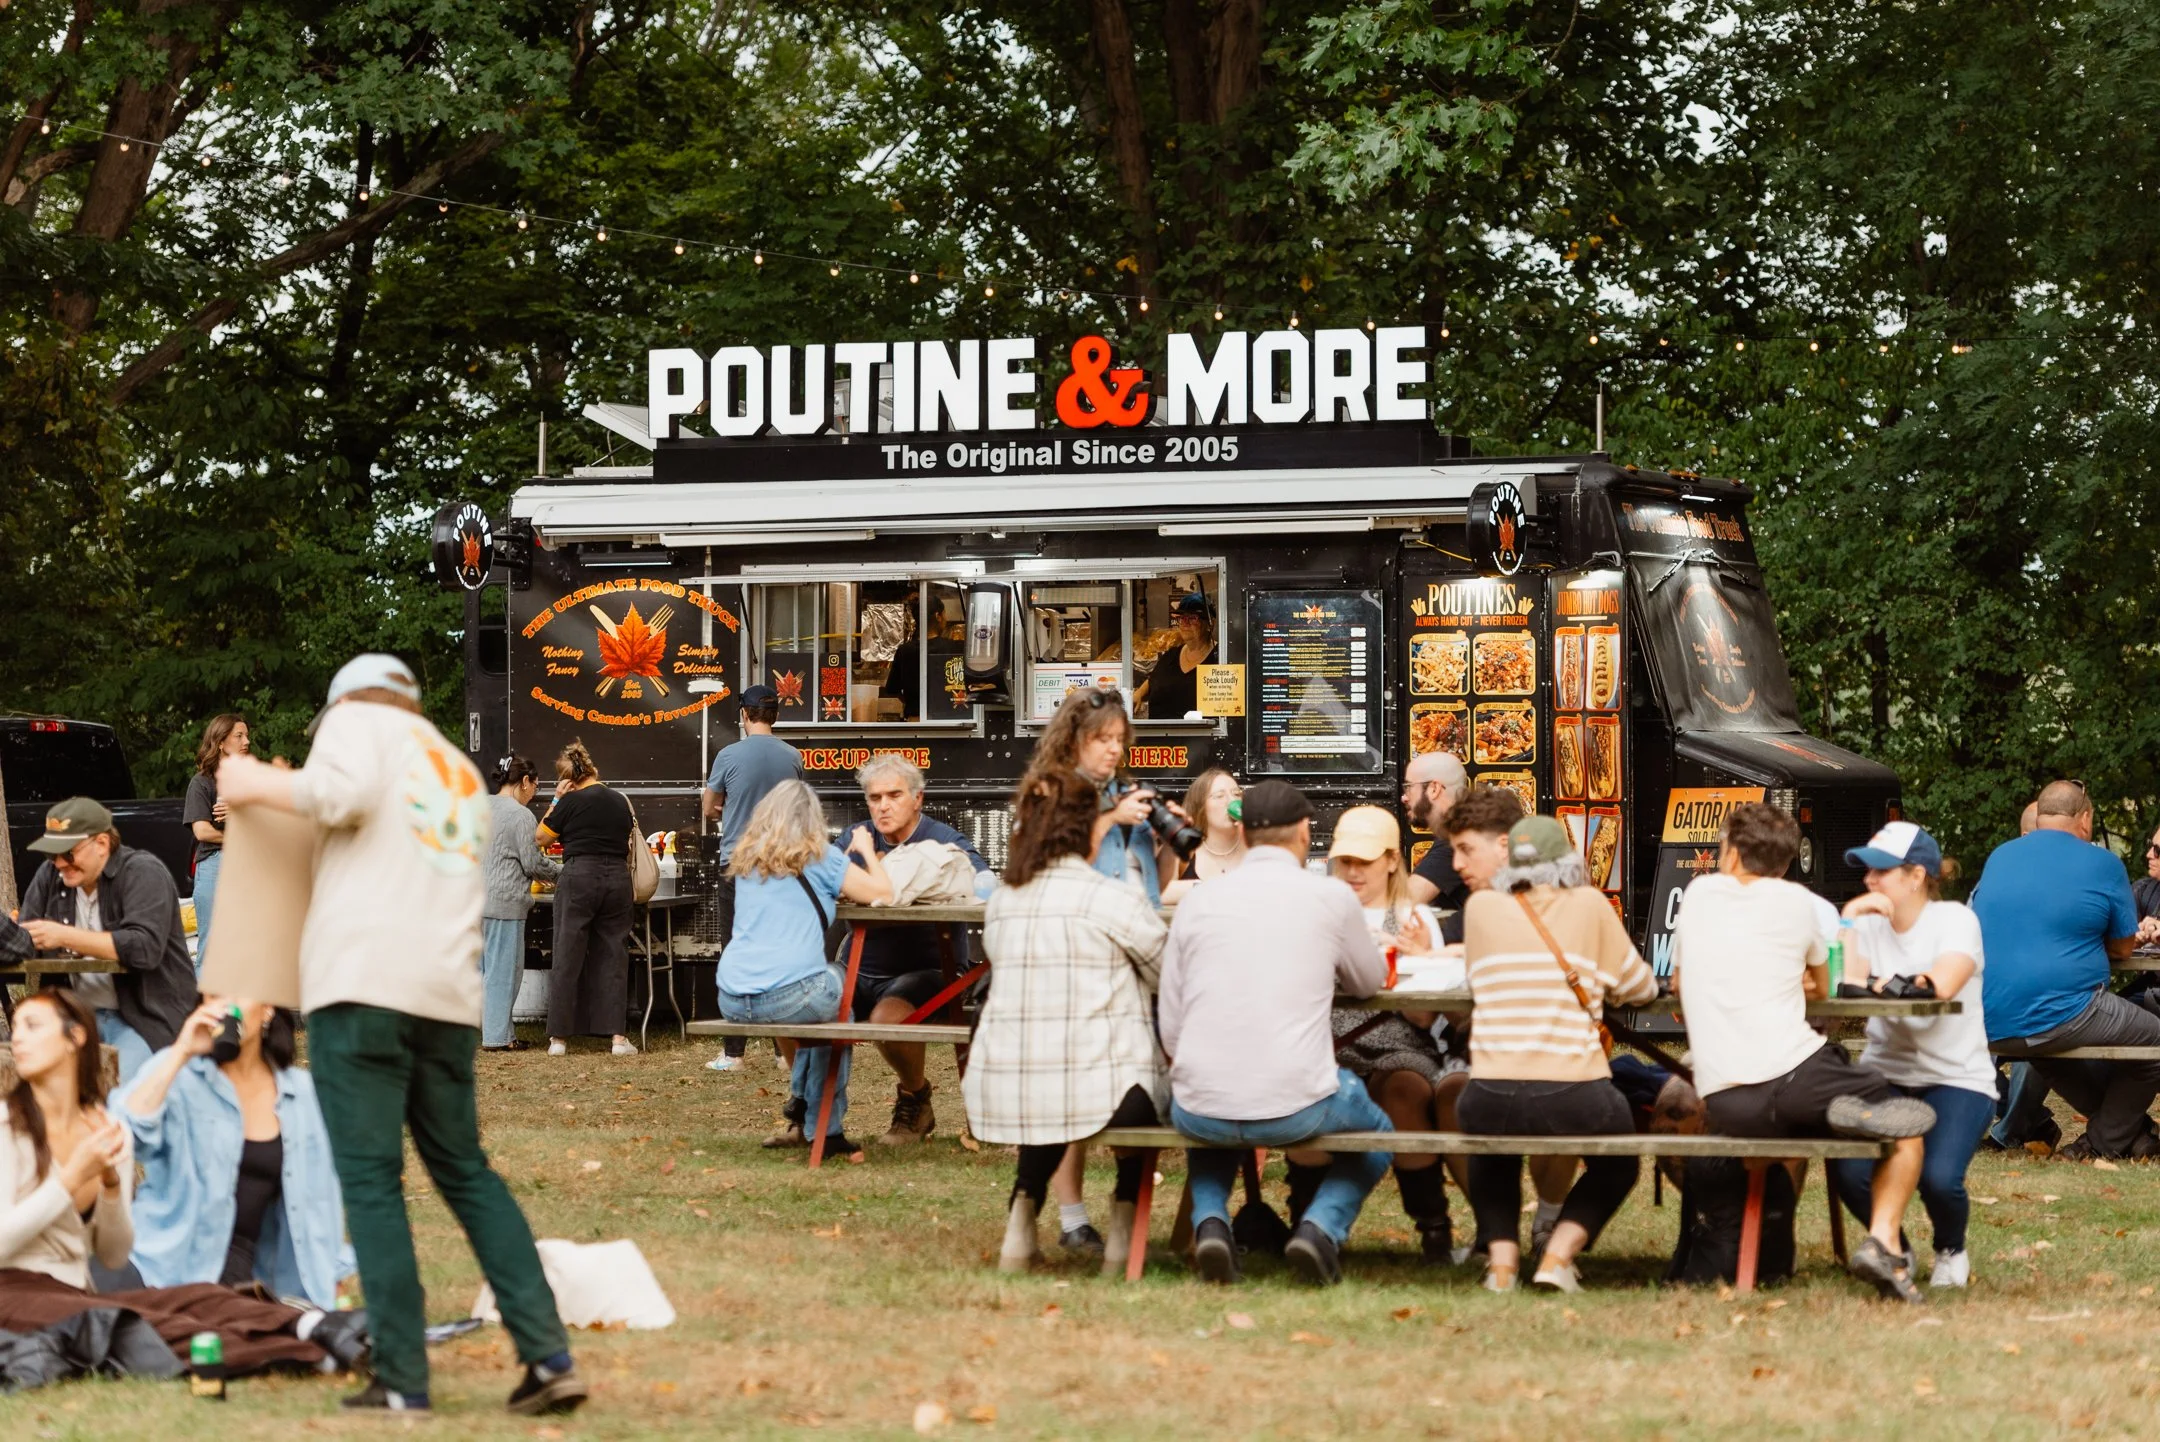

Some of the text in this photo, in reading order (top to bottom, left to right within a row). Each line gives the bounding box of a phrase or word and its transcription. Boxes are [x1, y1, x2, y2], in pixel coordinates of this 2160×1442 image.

[649, 326, 1426, 438] POUTINE & MORE
[882, 436, 1239, 474] The Original Since 2005
[1489, 484, 1525, 528] POUTINE
[453, 504, 492, 547] POUTINE
[1685, 510, 1714, 539] Food
[522, 578, 740, 639] THE ULTIMATE FOOD TRUCK
[1427, 583, 1516, 616] POUTINES
[1556, 590, 1619, 616] JUMBO HOT DOGS
[1416, 616, 1439, 626] ALWAYS
[1440, 616, 1458, 626] HAND
[1460, 616, 1473, 626] CUT
[1480, 616, 1501, 626] NEVER
[1503, 615, 1528, 625] FROZEN
[542, 645, 584, 660] Nothing
[677, 644, 719, 659] Simply
[546, 662, 580, 677] Fancy
[673, 661, 723, 674] Delicious
[1038, 679, 1060, 687] DEBIT
[1203, 676, 1238, 686] Speak Loudly
[531, 686, 731, 725] Serving Canada's Favourites
[1129, 747, 1187, 768] HERE
[1676, 860, 1684, 868] THE
[1684, 860, 1704, 868] ULTIMATE
[1704, 860, 1716, 868] FOOD
